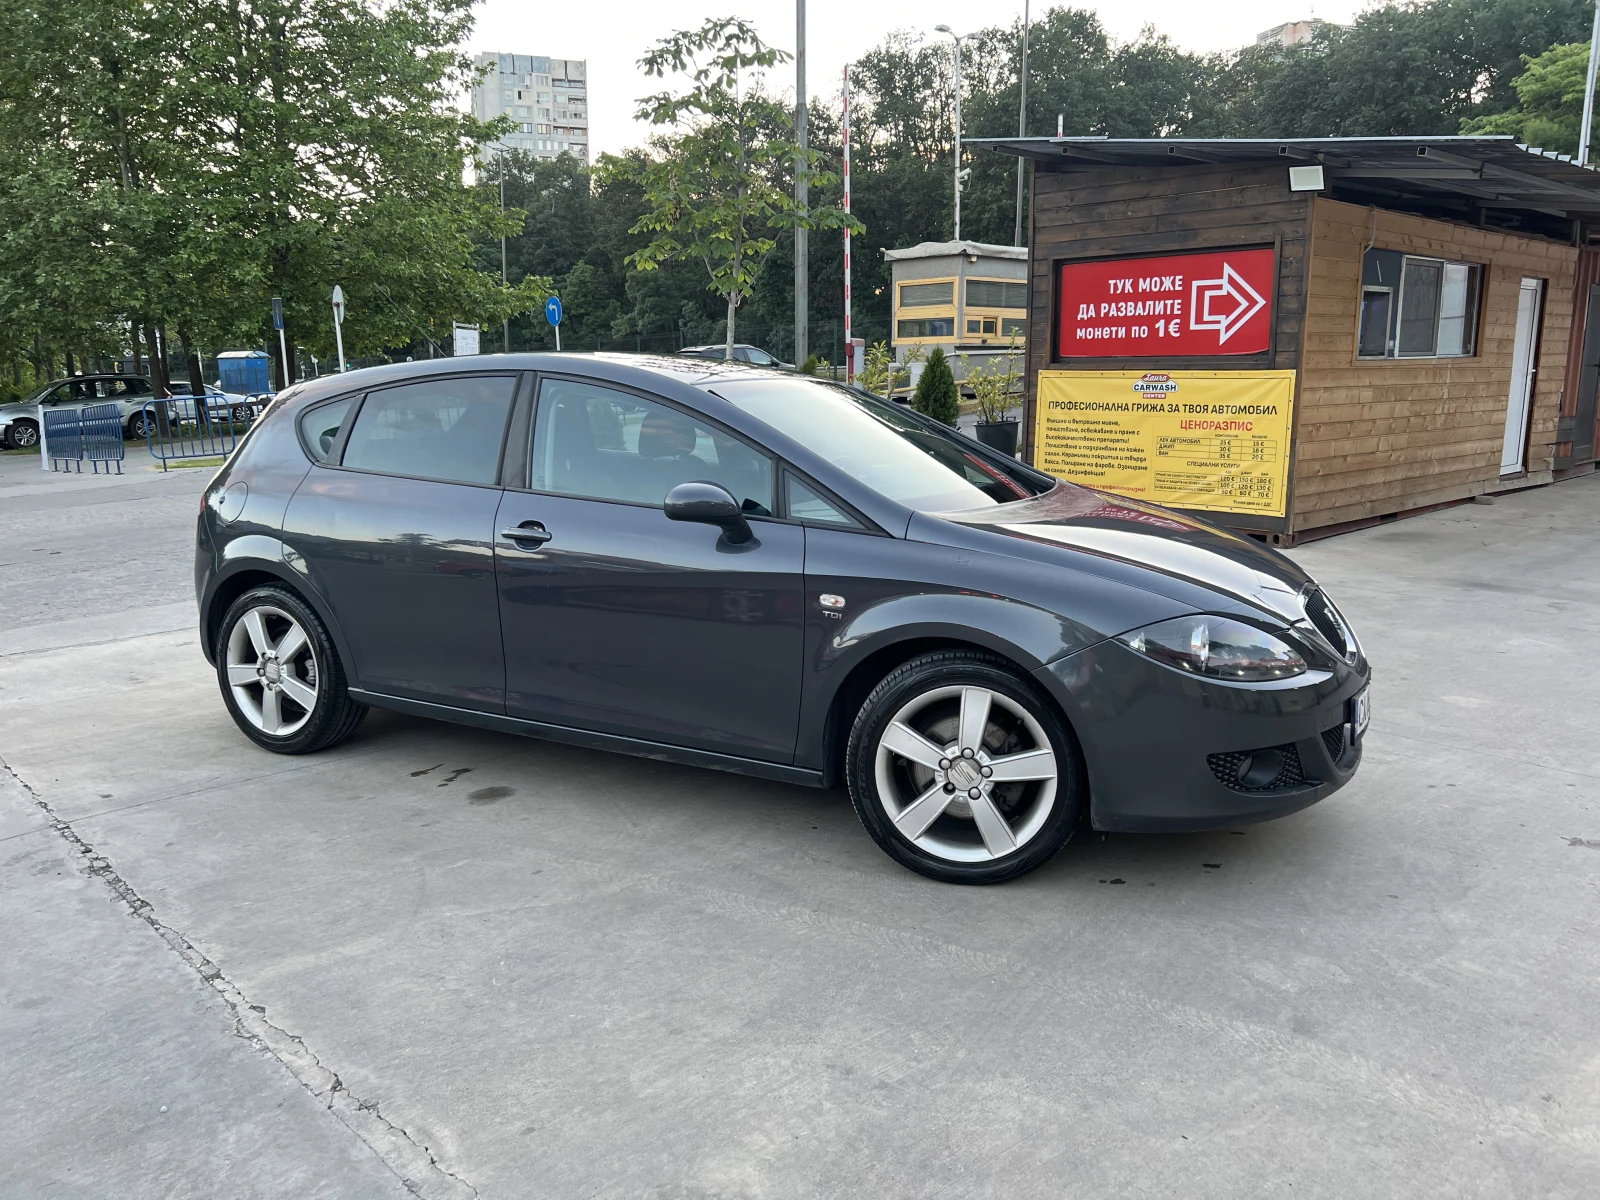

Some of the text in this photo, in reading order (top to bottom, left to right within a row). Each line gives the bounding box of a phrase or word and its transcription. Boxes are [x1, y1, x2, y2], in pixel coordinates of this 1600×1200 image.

[1108, 276, 1184, 294] ТУК МОЖЕ
[1078, 300, 1182, 320] ДА РАЗВАЛИТЕ
[1076, 319, 1181, 340] монети по 1€
[1144, 374, 1168, 382] Laura
[1048, 401, 1277, 415] ПРОФЕСИОНАЛНА ГРИЖА ЗА ТВОЯ АВТОМОБИЛ
[1180, 420, 1253, 431] ЦЕНОРАЗПИС
[822, 610, 842, 620] TDI
